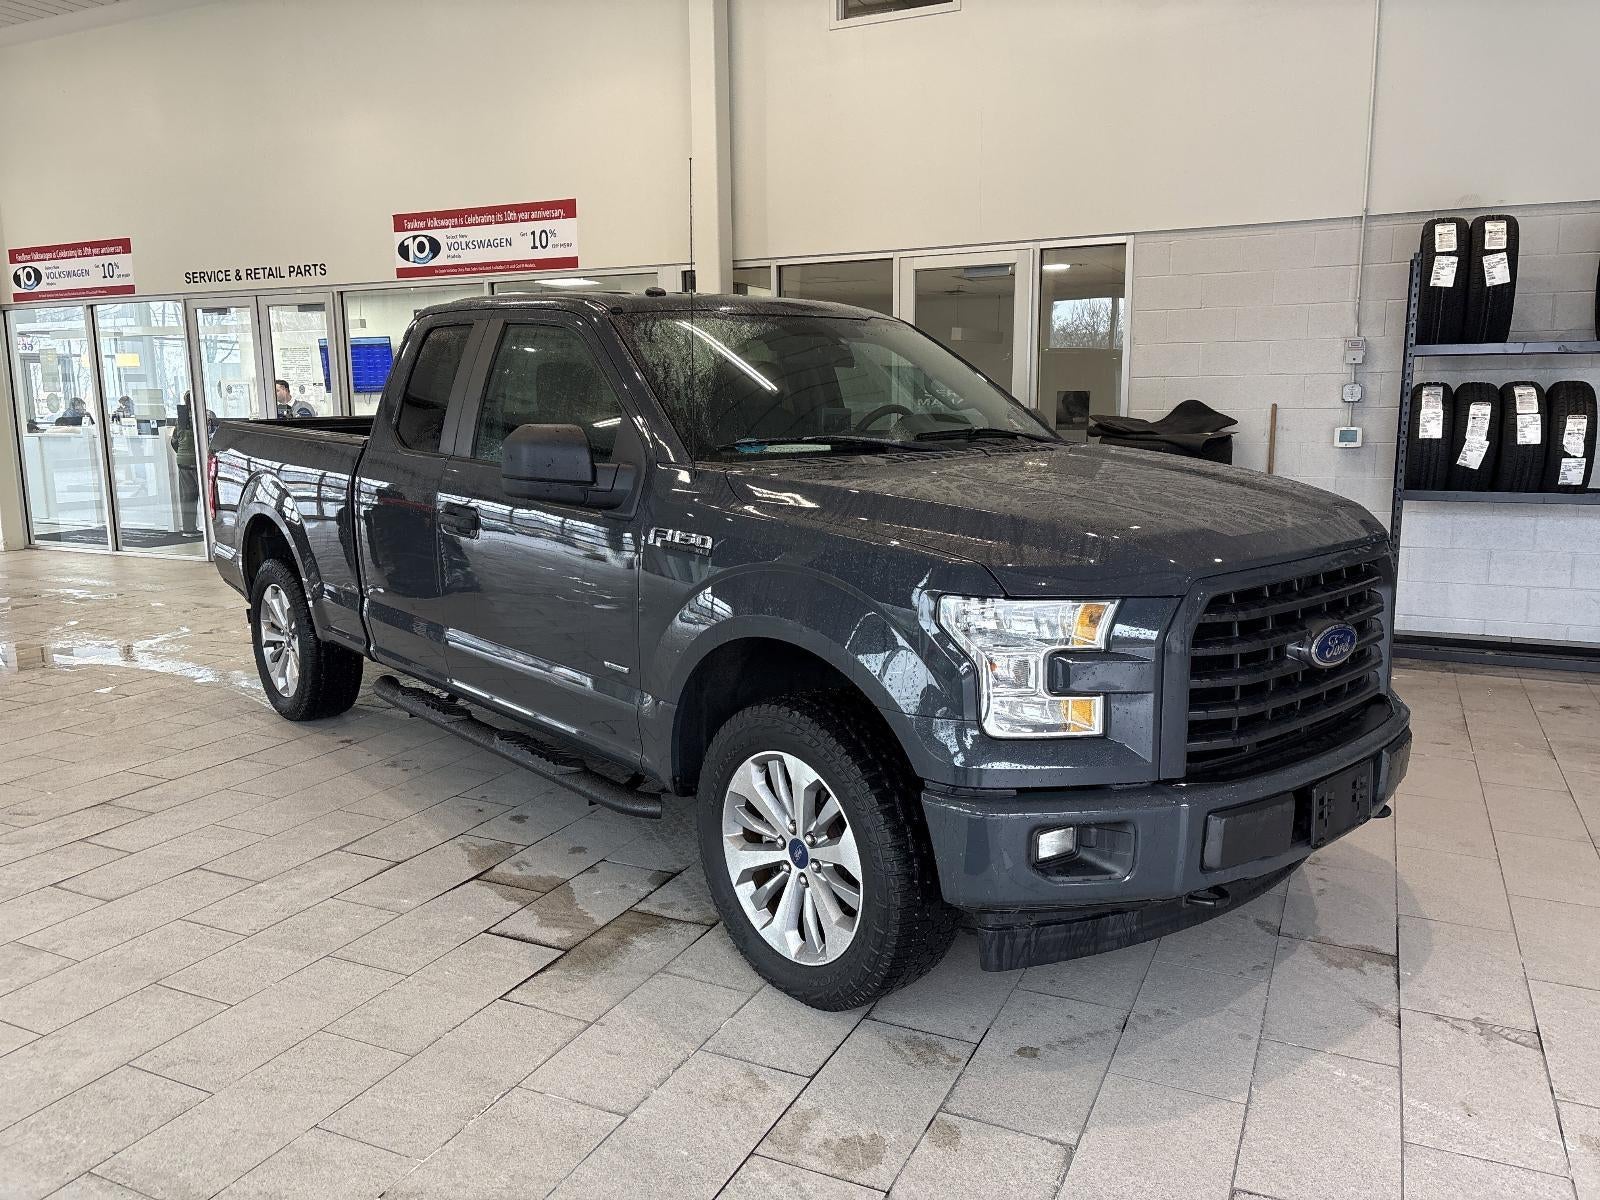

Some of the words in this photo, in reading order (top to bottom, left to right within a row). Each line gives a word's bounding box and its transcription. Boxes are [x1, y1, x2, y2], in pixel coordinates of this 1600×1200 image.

[404, 218, 426, 230] Faulkner
[427, 217, 458, 229] Volkswagen
[459, 214, 464, 225] is
[465, 212, 495, 225] Celebrating
[504, 210, 517, 221] 10th
[518, 211, 530, 223] year
[531, 208, 566, 219] anniversary.
[403, 236, 430, 262] 10
[446, 237, 512, 252] VOLKSWAGEN
[16, 267, 35, 288] 10
[45, 269, 90, 279] VOLKSWAGEN
[184, 269, 231, 284] SERVICE
[234, 268, 242, 281] &
[245, 266, 285, 280] RETAIL
[288, 263, 327, 277] PARTS
[1326, 633, 1351, 658] Ford
